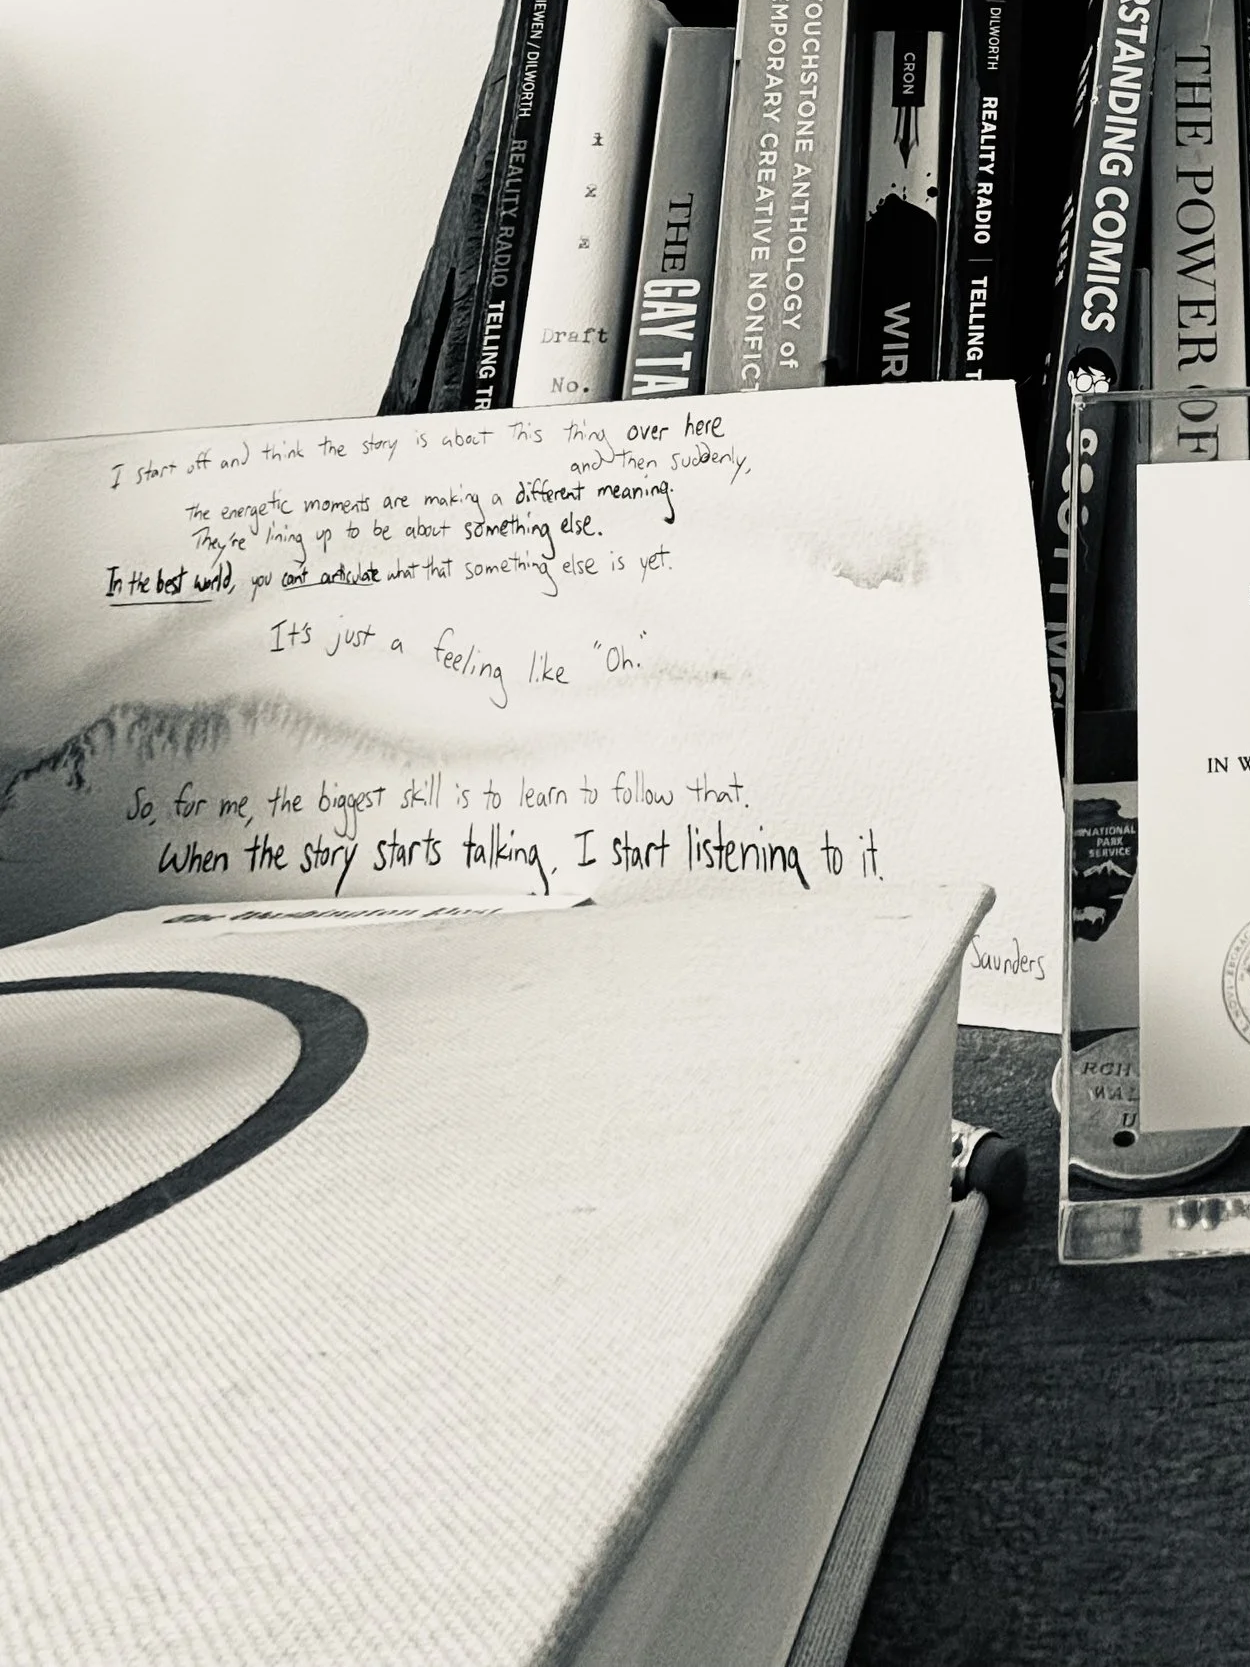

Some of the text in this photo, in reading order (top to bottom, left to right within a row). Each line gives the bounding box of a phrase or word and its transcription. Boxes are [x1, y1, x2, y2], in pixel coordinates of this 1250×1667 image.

[902, 51, 916, 96] CRON
[985, 6, 1004, 71] DILWORTH
[1174, 44, 1213, 148] THE
[749, 131, 780, 262] CREATIVE
[966, 95, 1000, 363] REALITY RADIO TELLING
[638, 192, 701, 345] THE GAY
[780, 159, 813, 332] ANTHOLOGY
[1079, 185, 1131, 335] COMICS
[1174, 164, 1220, 372] POWER
[541, 324, 609, 345] Draft
[550, 376, 591, 394] No.
[158, 820, 886, 897] When the story starts talking, I start listening to it.
[1088, 845, 1132, 859] SERVICE
[1096, 837, 1124, 848] PARK
[968, 934, 1049, 982] Saunders
